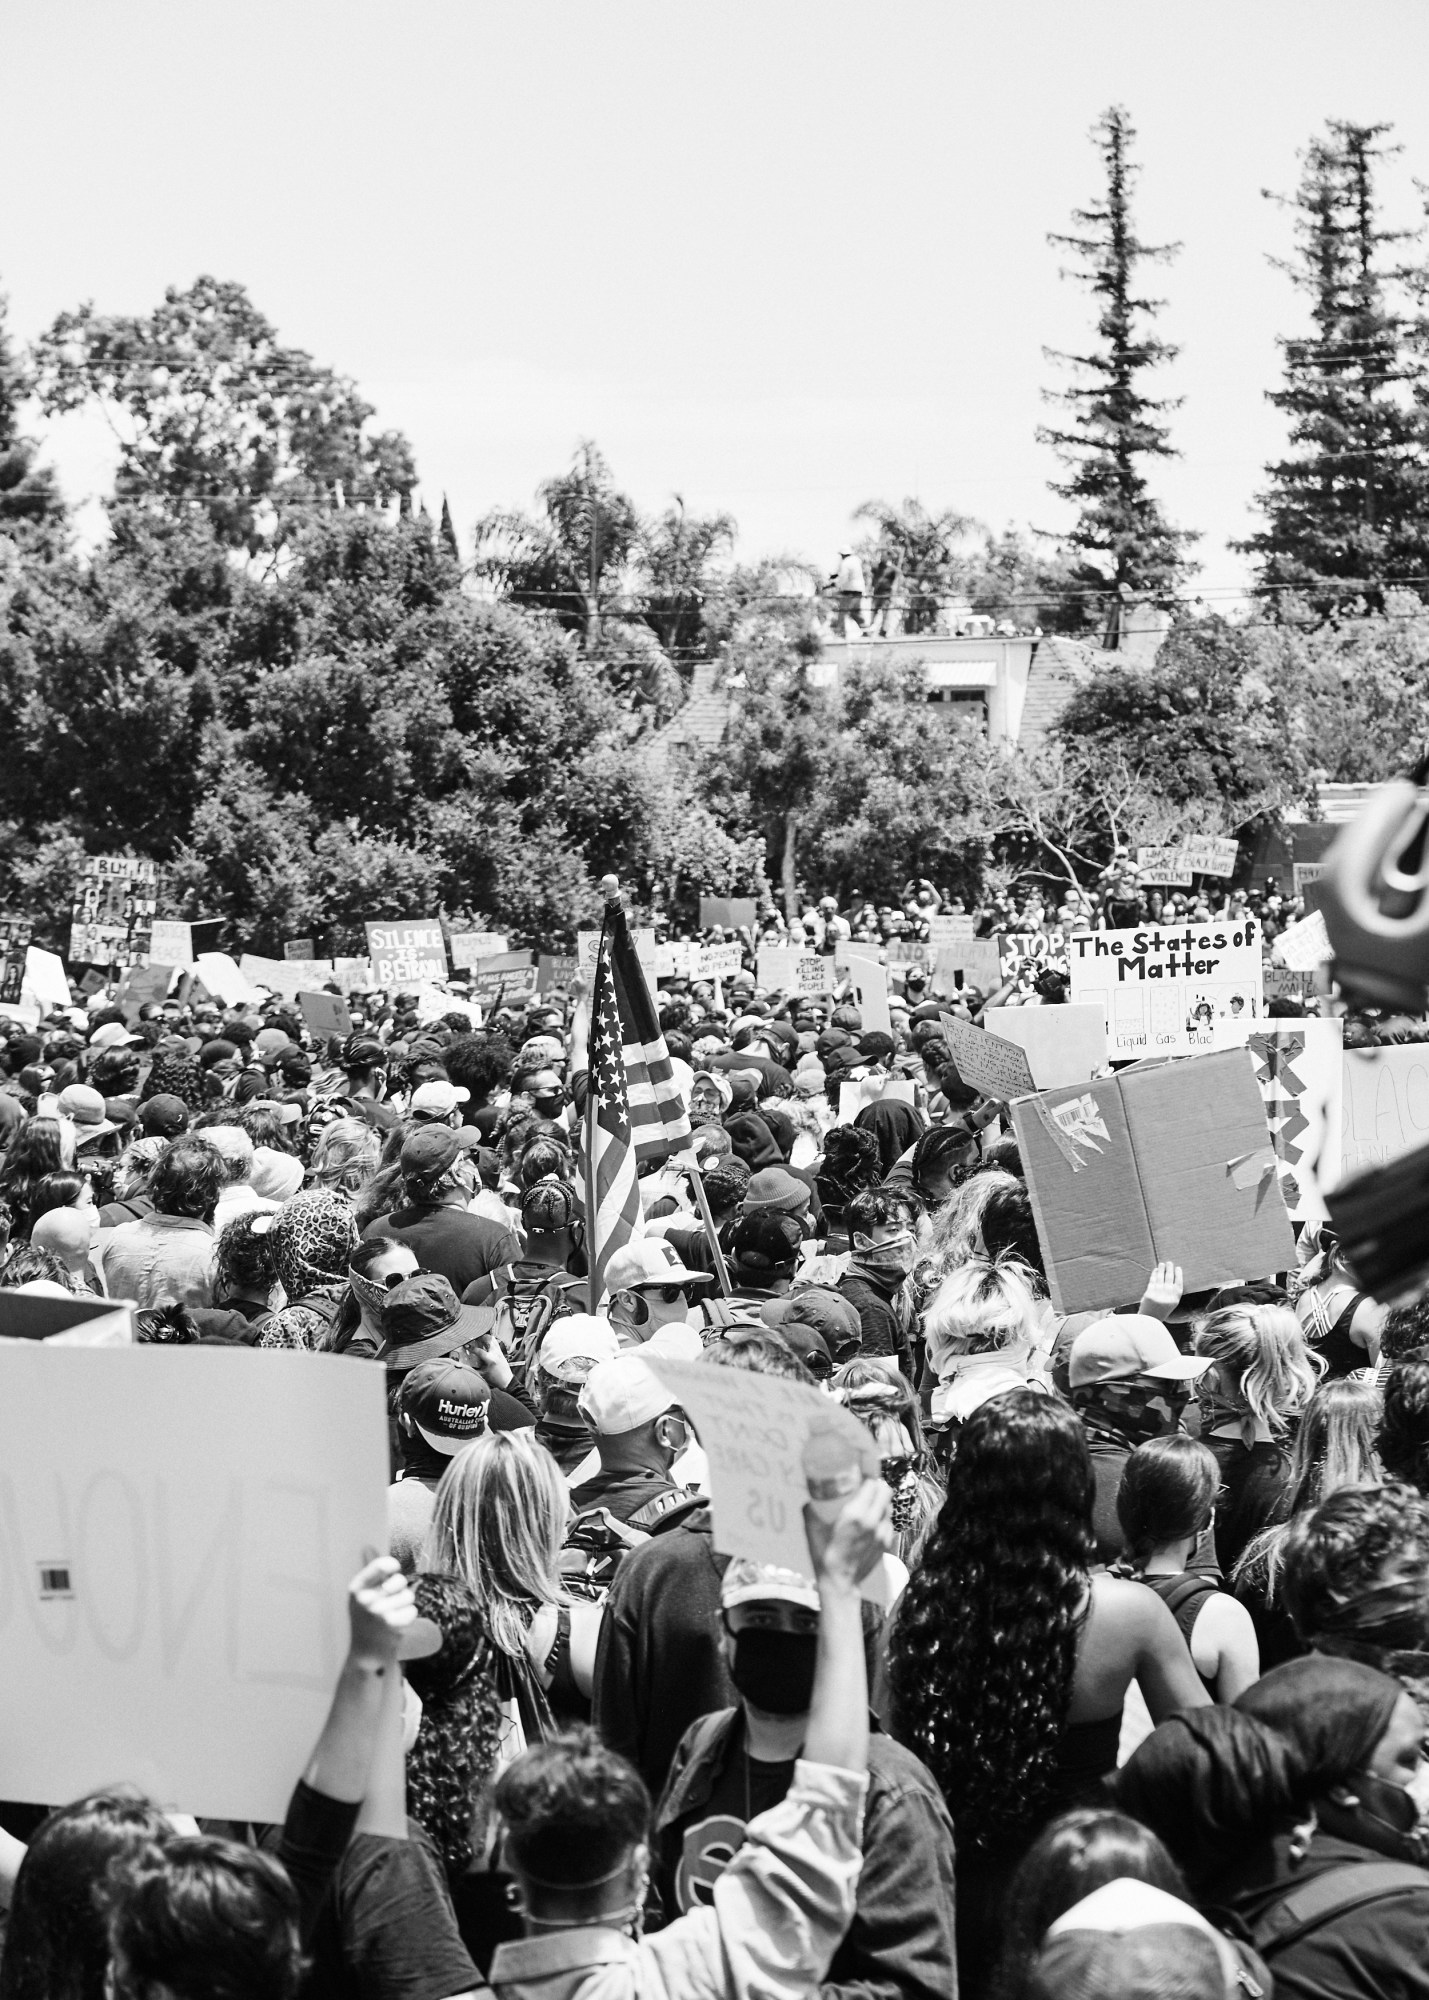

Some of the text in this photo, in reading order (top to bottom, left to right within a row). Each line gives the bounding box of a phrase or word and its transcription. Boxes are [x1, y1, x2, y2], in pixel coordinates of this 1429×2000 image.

[99, 858, 128, 875] BLM
[370, 928, 443, 950] SILENCE
[1072, 921, 1256, 957] The States of
[1006, 933, 1065, 958] STOP
[396, 948, 418, 961] IS
[700, 953, 713, 962] NO
[800, 957, 821, 967] STOP
[1118, 951, 1220, 982] Matter
[697, 964, 710, 974] NO
[796, 964, 825, 975] KILLING
[801, 974, 825, 982] BLACK
[1264, 971, 1299, 983] BLACK
[798, 982, 825, 991] PEOPLE
[1116, 1032, 1214, 1051] Liquid Gas Blac
[438, 1399, 482, 1418] Hurley
[438, 1415, 475, 1425] AUSTRALIAN
